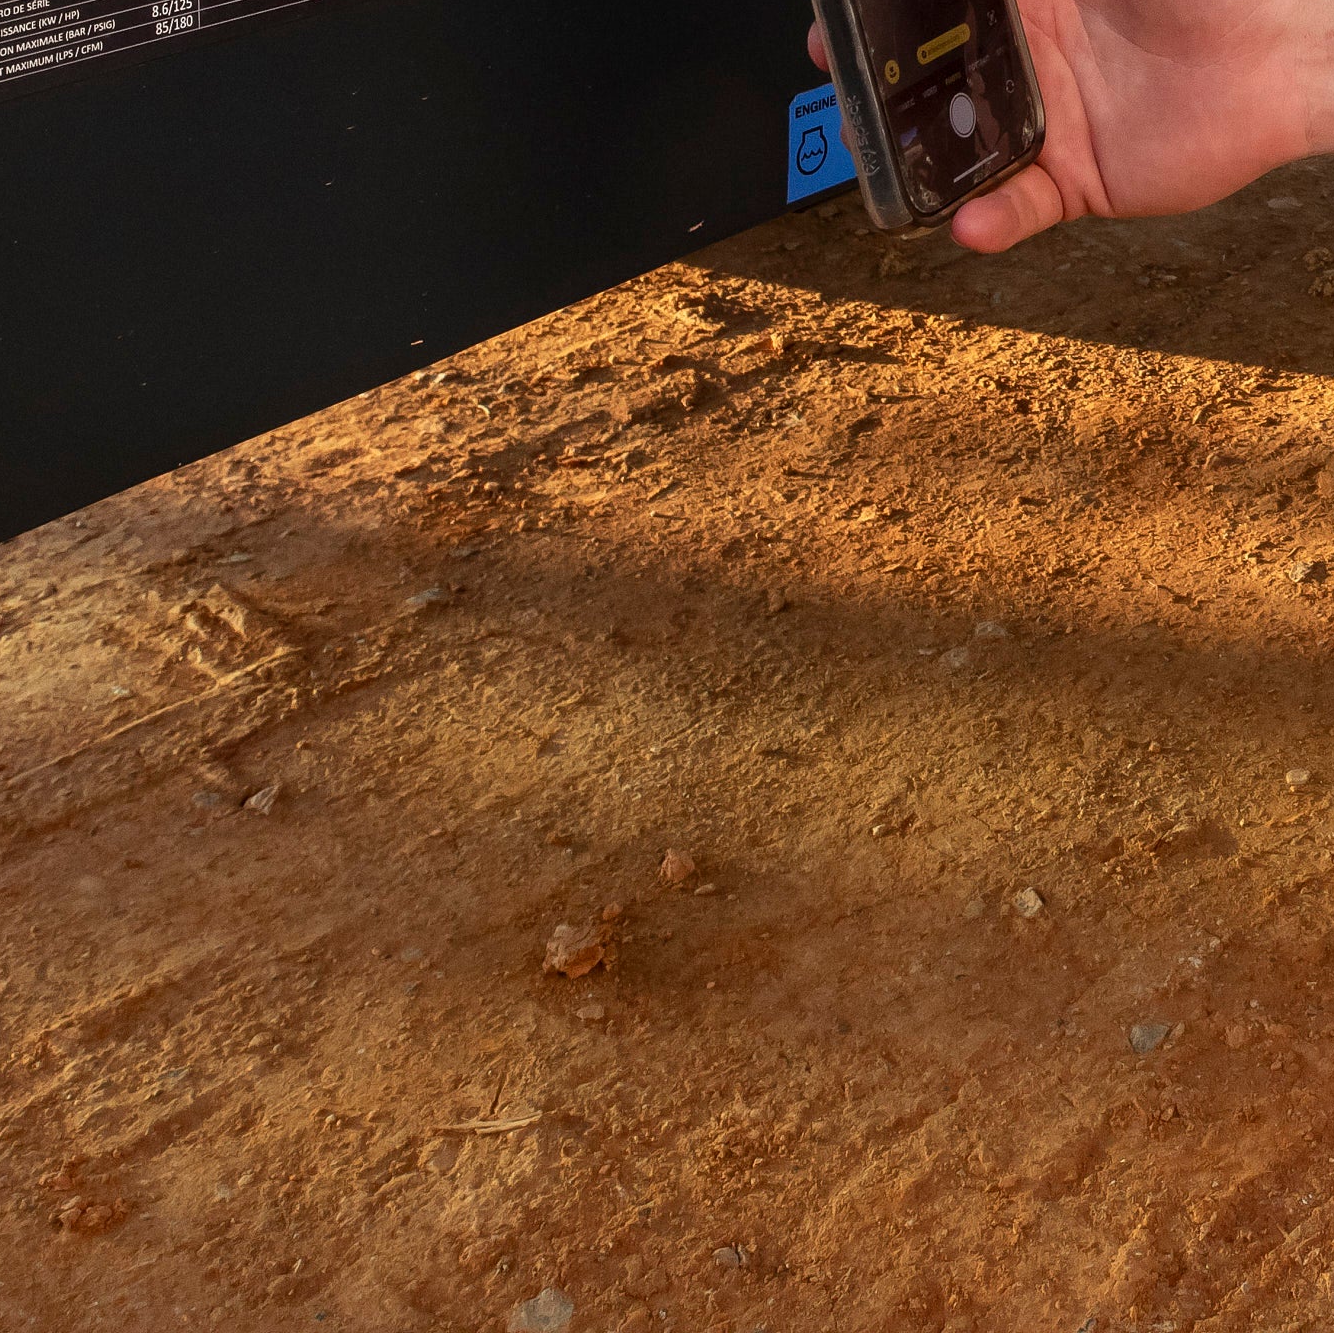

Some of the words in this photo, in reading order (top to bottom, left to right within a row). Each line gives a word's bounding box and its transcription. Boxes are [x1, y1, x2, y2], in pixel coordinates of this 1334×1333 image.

[12, 3, 25, 15] DE
[155, 14, 194, 36] 85/180
[16, 32, 64, 53] MAXIMALE
[5, 54, 54, 75] MAXIMUM
[795, 95, 837, 119] ENGINE
